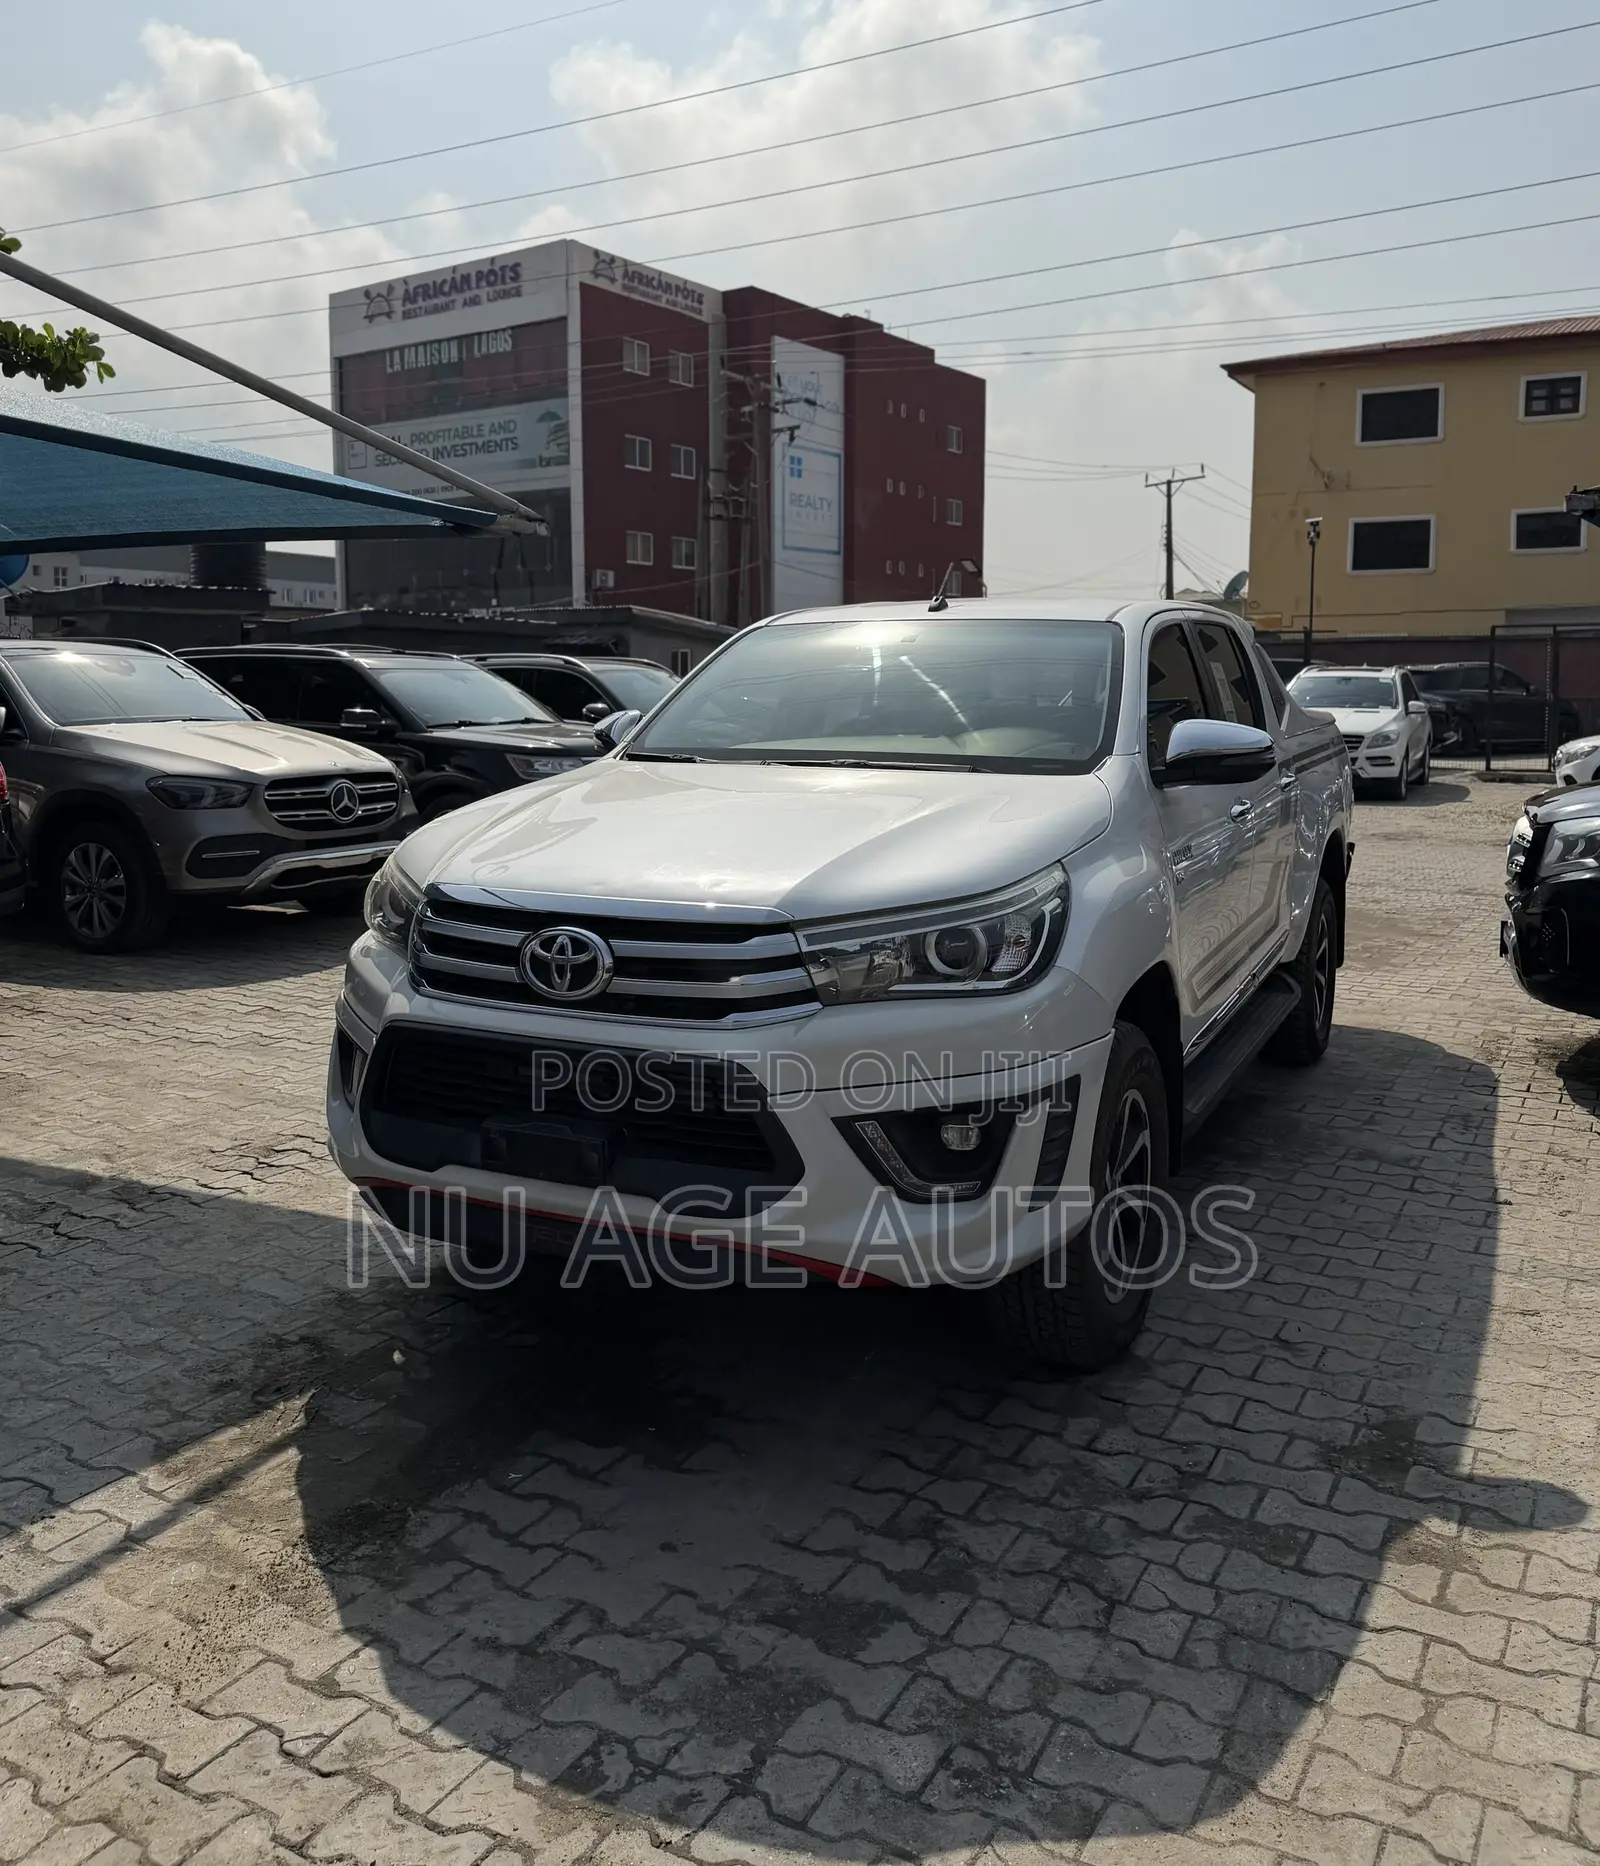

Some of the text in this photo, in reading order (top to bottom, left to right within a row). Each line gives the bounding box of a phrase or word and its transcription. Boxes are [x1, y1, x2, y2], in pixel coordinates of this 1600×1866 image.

[402, 285, 523, 320] RESTAURANT AND LOUNGE
[385, 328, 513, 375] LA MAISON LAGOS
[410, 423, 486, 446] PROFITABLE
[488, 419, 517, 436] AND
[432, 436, 519, 460] INVESTMENTS
[789, 491, 833, 512] REALTY
